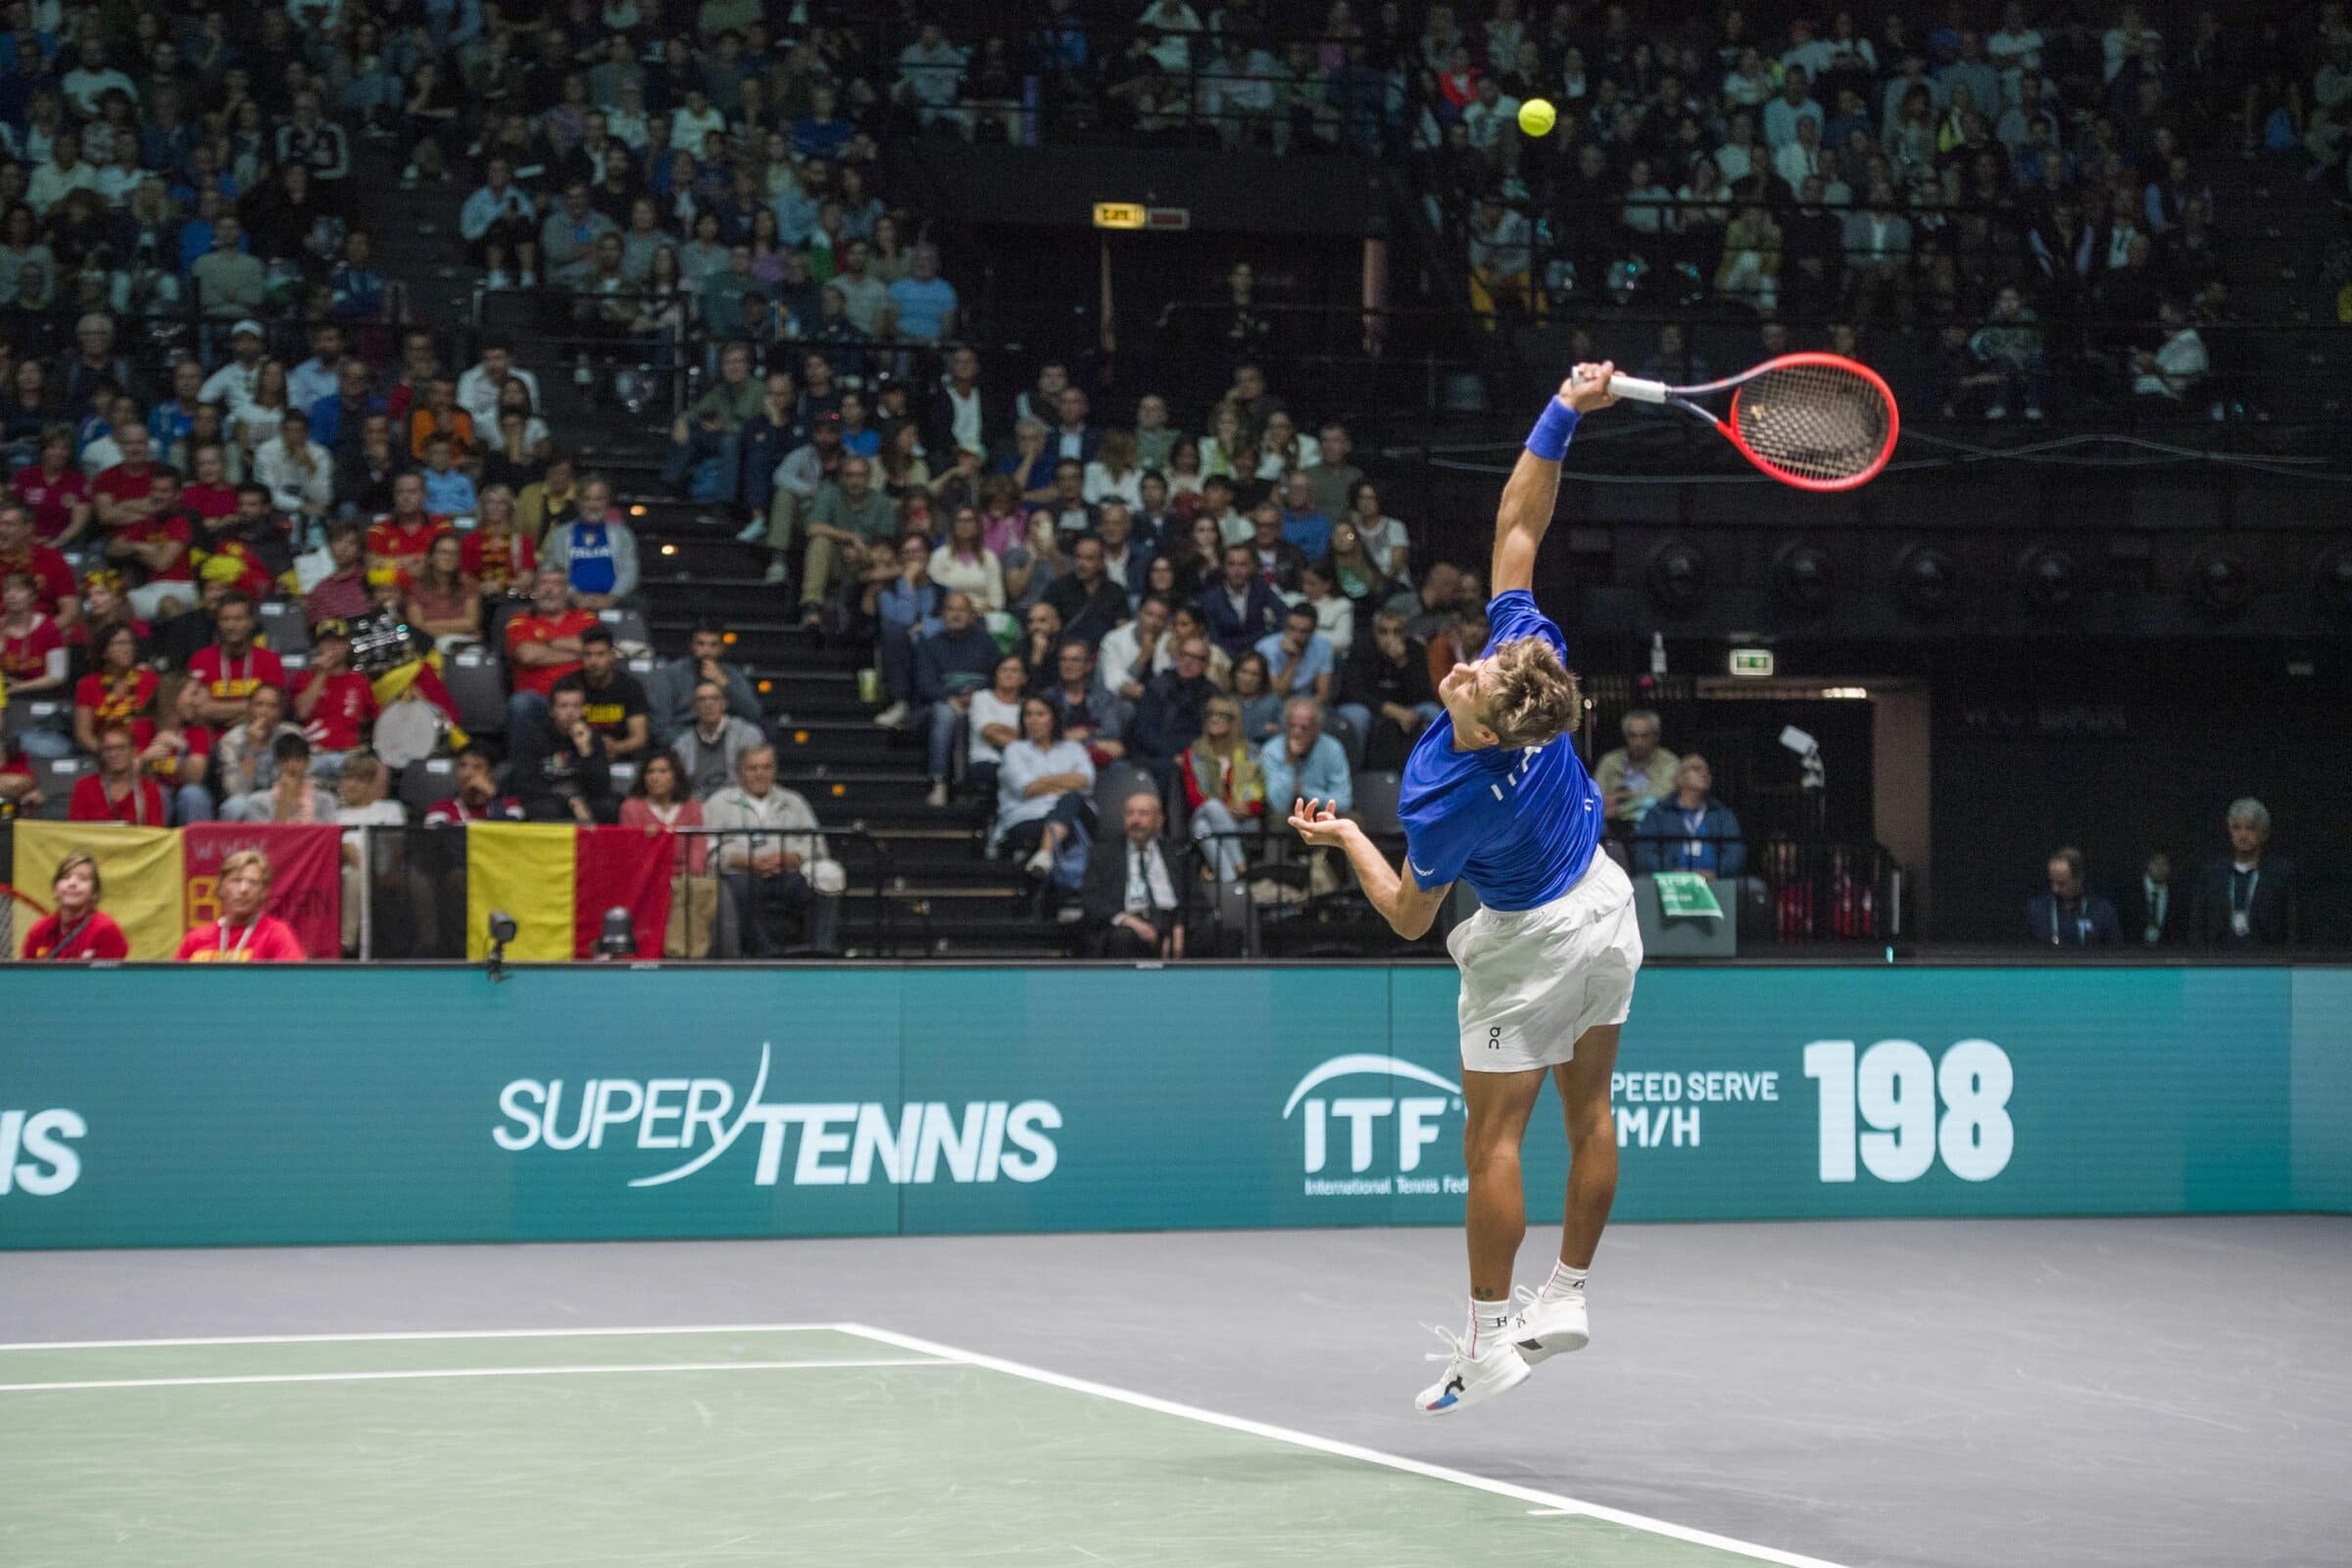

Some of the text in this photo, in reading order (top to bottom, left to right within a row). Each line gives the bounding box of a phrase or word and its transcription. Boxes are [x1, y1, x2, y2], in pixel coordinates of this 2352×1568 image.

[1610, 1070, 1779, 1102] PEED SERVE
[1804, 1039, 2014, 1183] 198
[492, 1078, 1063, 1186] SUPER TENNIS
[1304, 1098, 1447, 1174] ITF
[1612, 1105, 1700, 1148] M/H
[1304, 1176, 1392, 1196] International
[1396, 1175, 1440, 1195] Tennis
